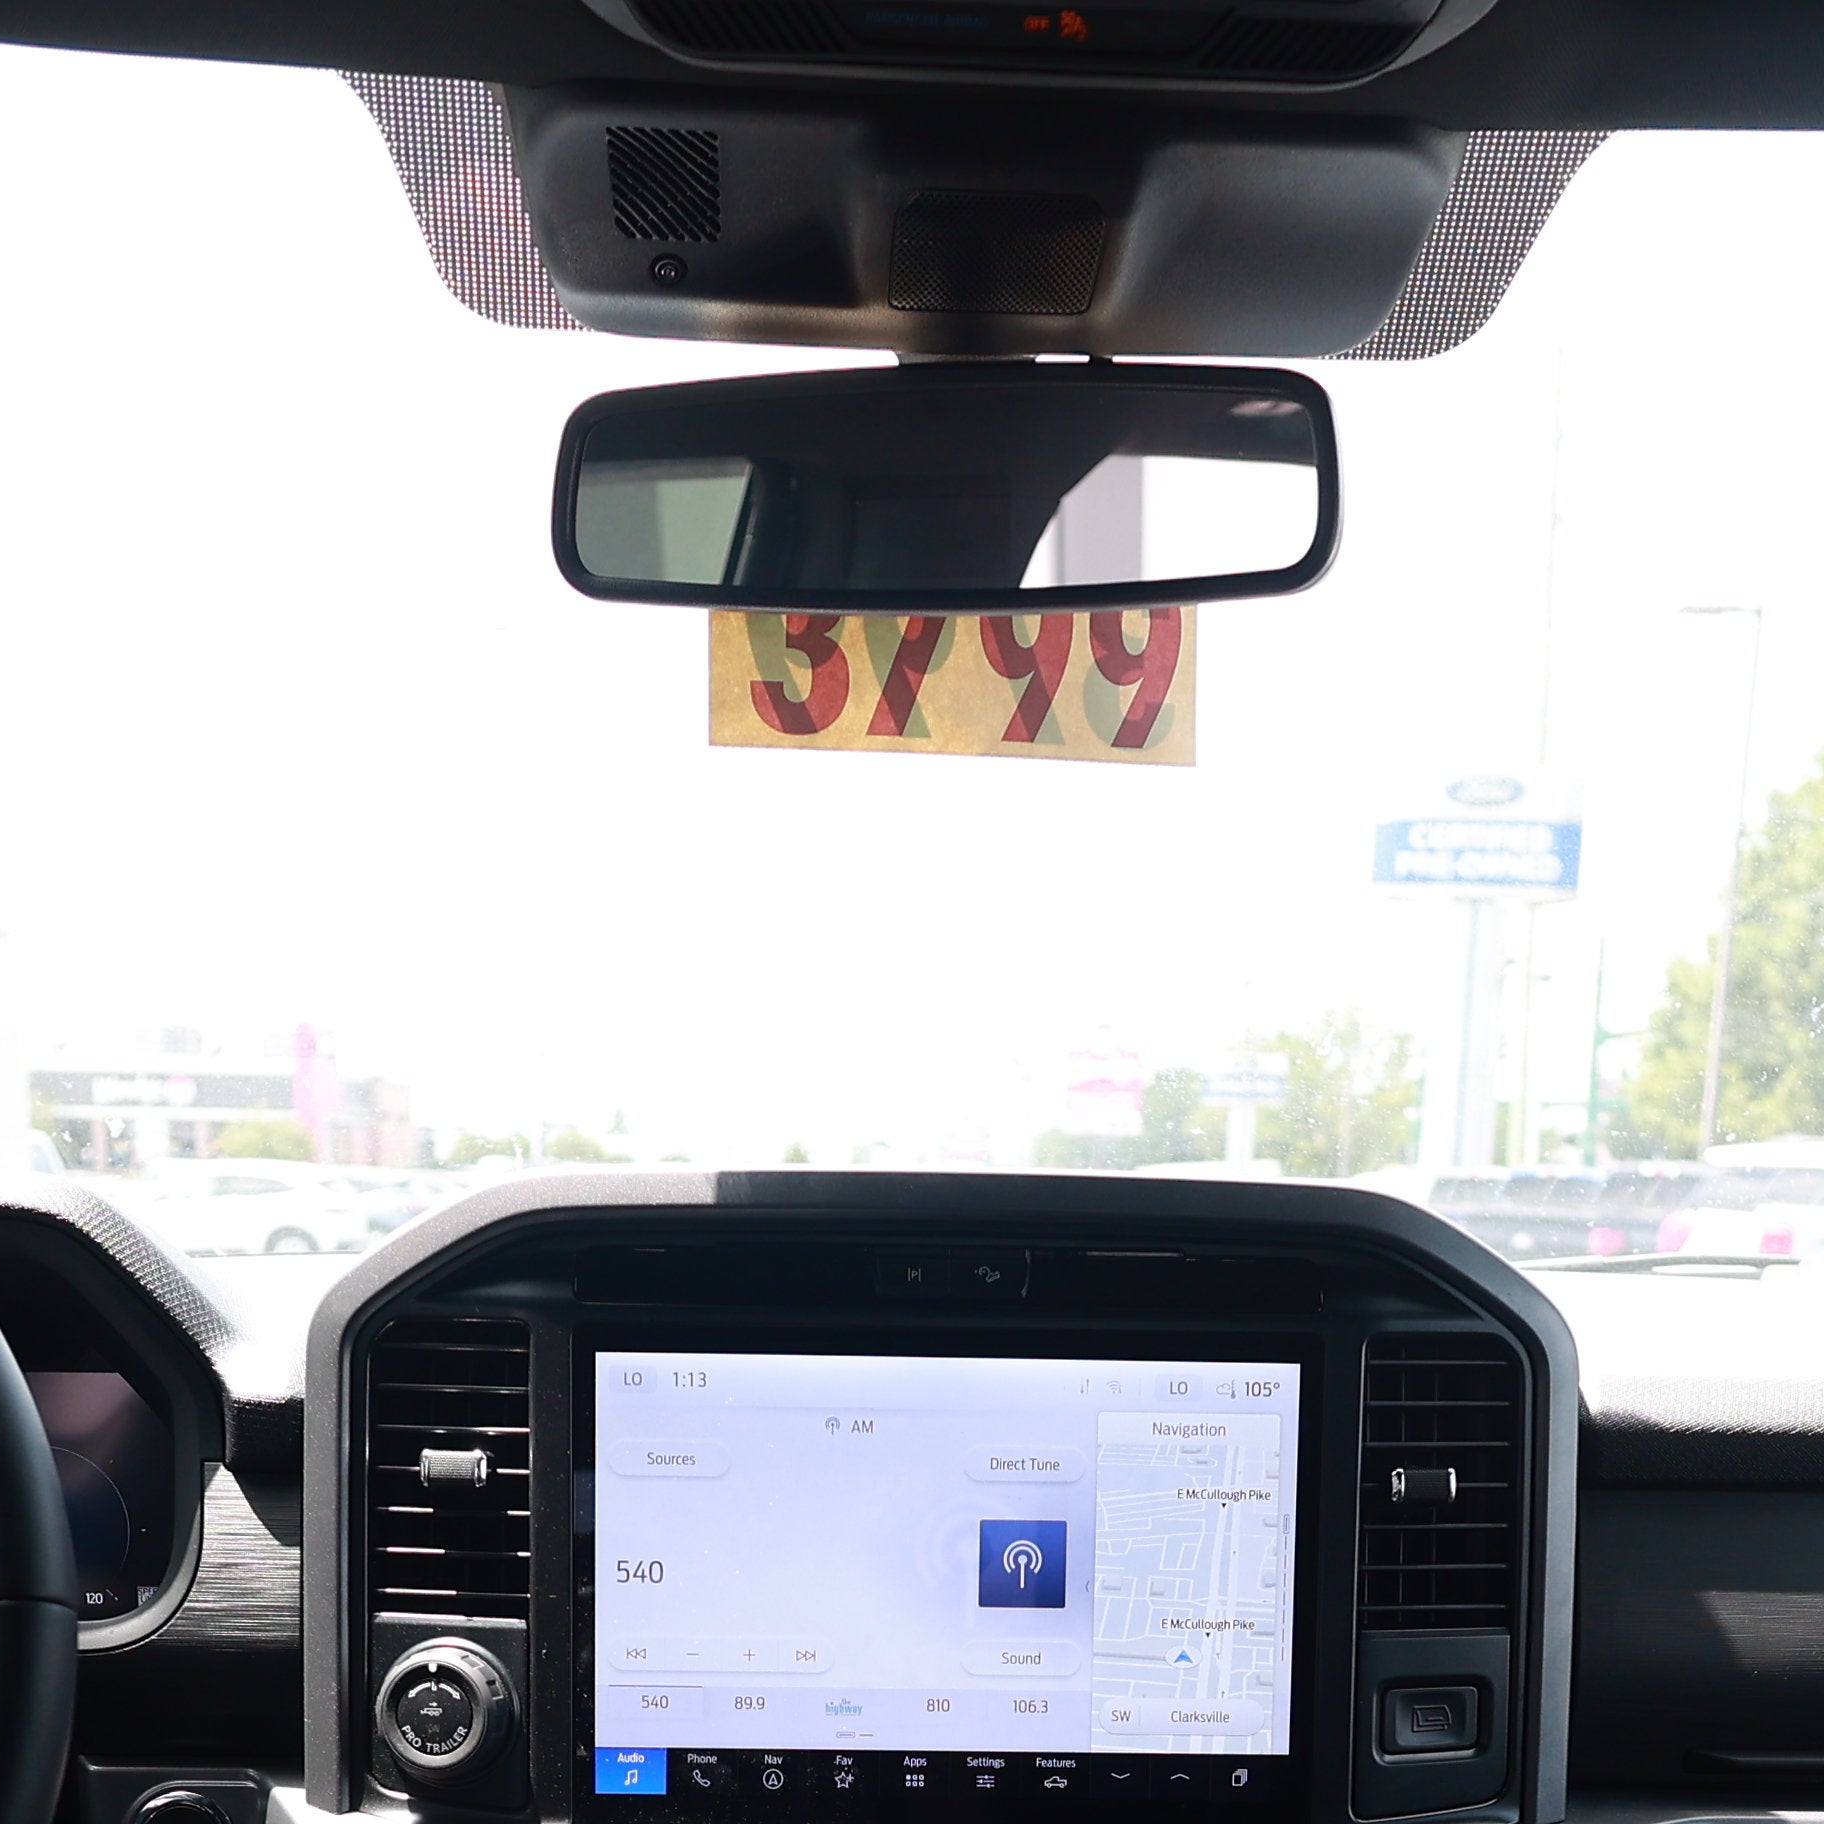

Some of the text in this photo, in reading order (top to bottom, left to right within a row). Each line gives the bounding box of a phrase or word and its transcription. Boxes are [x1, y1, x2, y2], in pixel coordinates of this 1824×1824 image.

[624, 1372, 643, 1386] LO
[673, 1372, 707, 1388] 1:13
[1169, 1381, 1188, 1395] LO
[851, 1420, 874, 1433] AM
[1152, 1422, 1226, 1437] Navigation
[647, 1452, 696, 1466] Sources
[990, 1457, 1060, 1471] Direct Tune
[1177, 1489, 1271, 1502] E McCullough Pike
[616, 1560, 664, 1584] 540
[85, 1592, 103, 1605] 120
[1161, 1619, 1255, 1632] E McCullough Pike
[1001, 1652, 1041, 1665] Sound
[641, 1696, 669, 1710] 540
[734, 1696, 765, 1710] 89.9
[826, 1702, 862, 1716] highway
[926, 1699, 950, 1712] 810
[1013, 1700, 1048, 1714] 106.3
[1112, 1711, 1131, 1722] SW
[1170, 1711, 1230, 1724] Clarksville
[401, 1725, 469, 1754] PRO TRAILER
[617, 1753, 645, 1765] Audio
[687, 1753, 717, 1765] Phone
[765, 1754, 783, 1765] Nav
[836, 1755, 853, 1767] Fav
[904, 1756, 927, 1768] Apps
[967, 1757, 1005, 1769] Settings
[1036, 1758, 1076, 1769] Features
